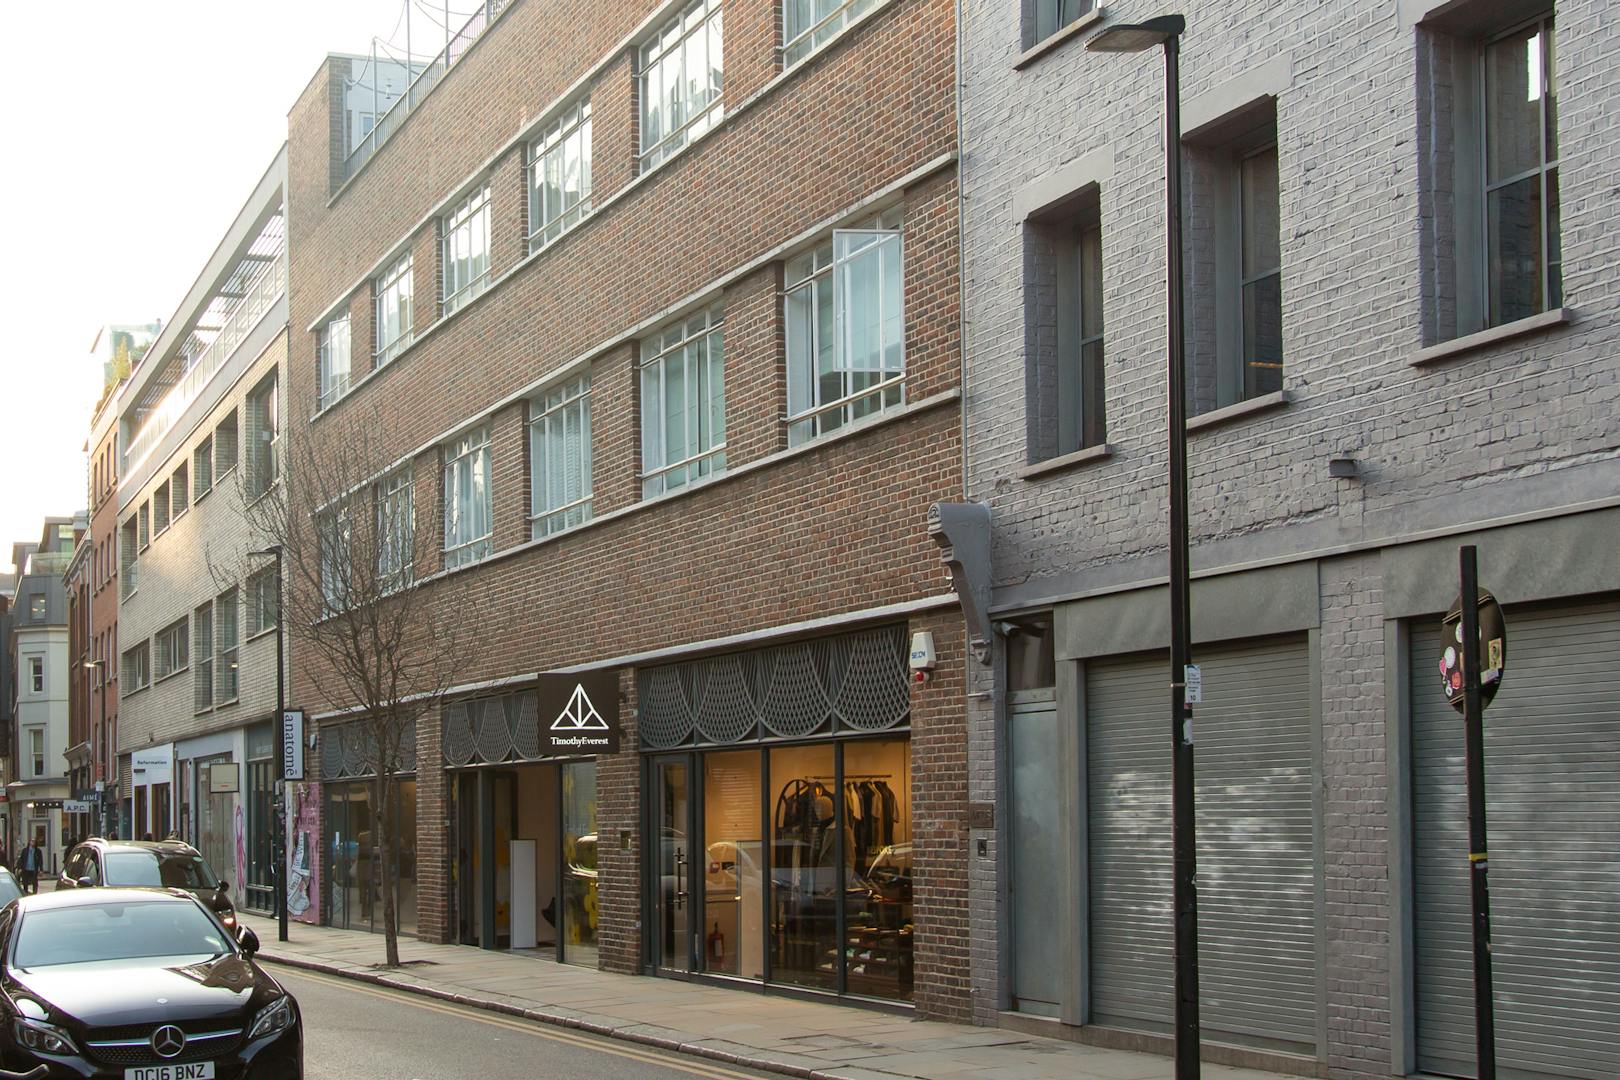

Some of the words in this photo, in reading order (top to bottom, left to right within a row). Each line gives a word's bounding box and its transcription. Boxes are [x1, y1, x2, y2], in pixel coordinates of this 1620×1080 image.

[284, 714, 298, 776] anatomē
[134, 1067, 170, 1080] DC16
[175, 1064, 205, 1080] BNZ
